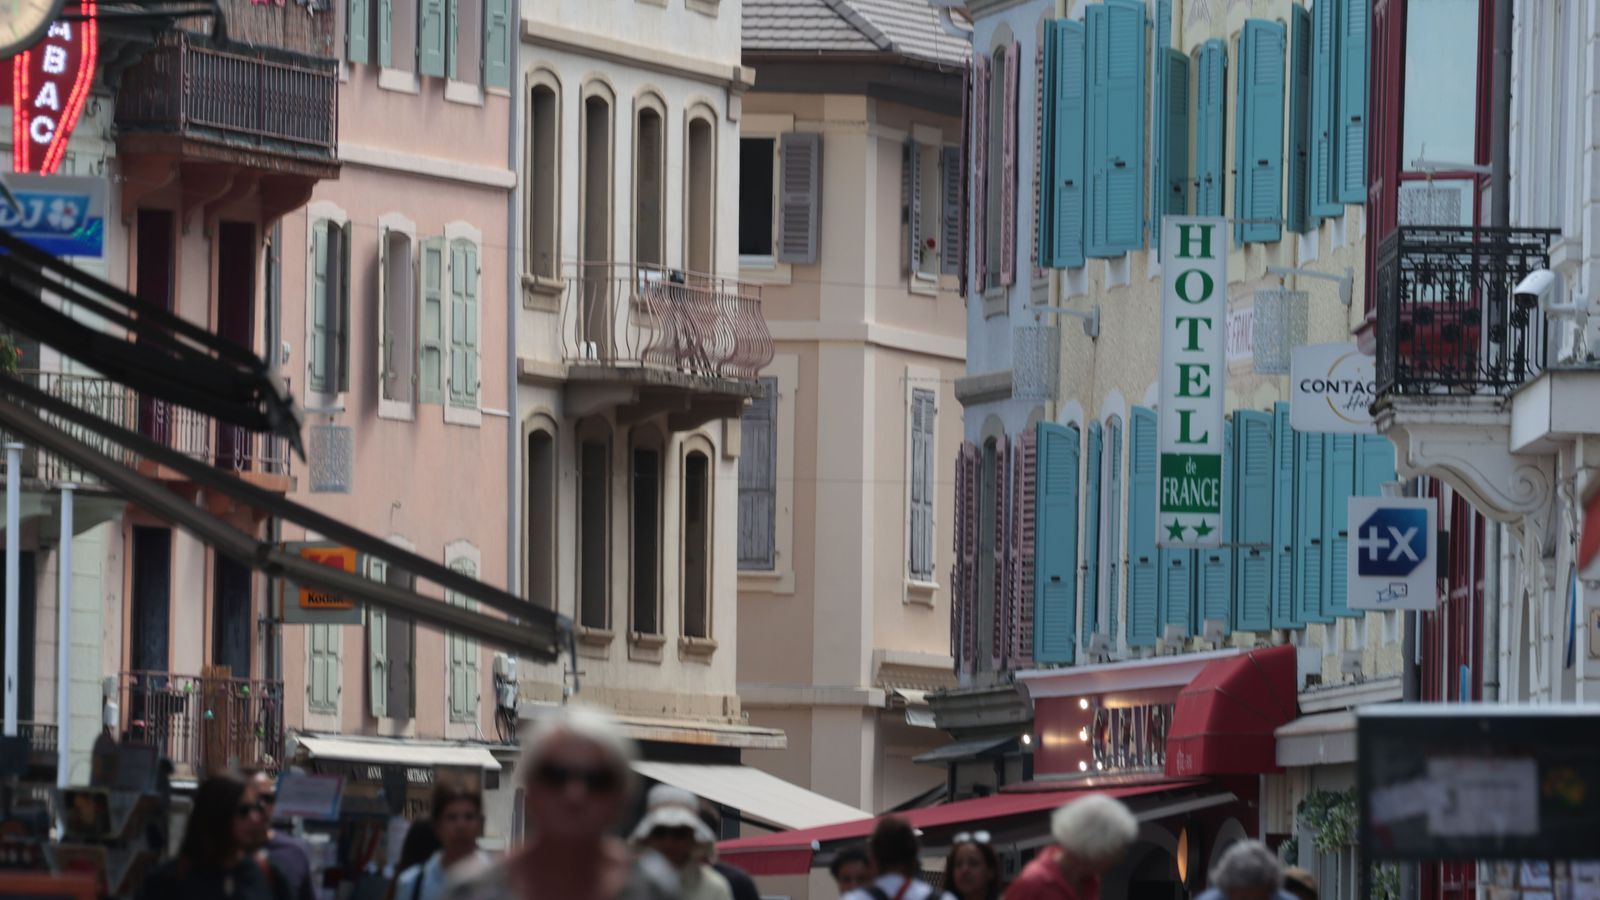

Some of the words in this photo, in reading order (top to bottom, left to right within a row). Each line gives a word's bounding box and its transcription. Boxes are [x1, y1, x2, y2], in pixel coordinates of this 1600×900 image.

[1174, 223, 1216, 445] HOTEL
[1185, 455, 1197, 475] de
[1162, 477, 1219, 507] FRANCE
